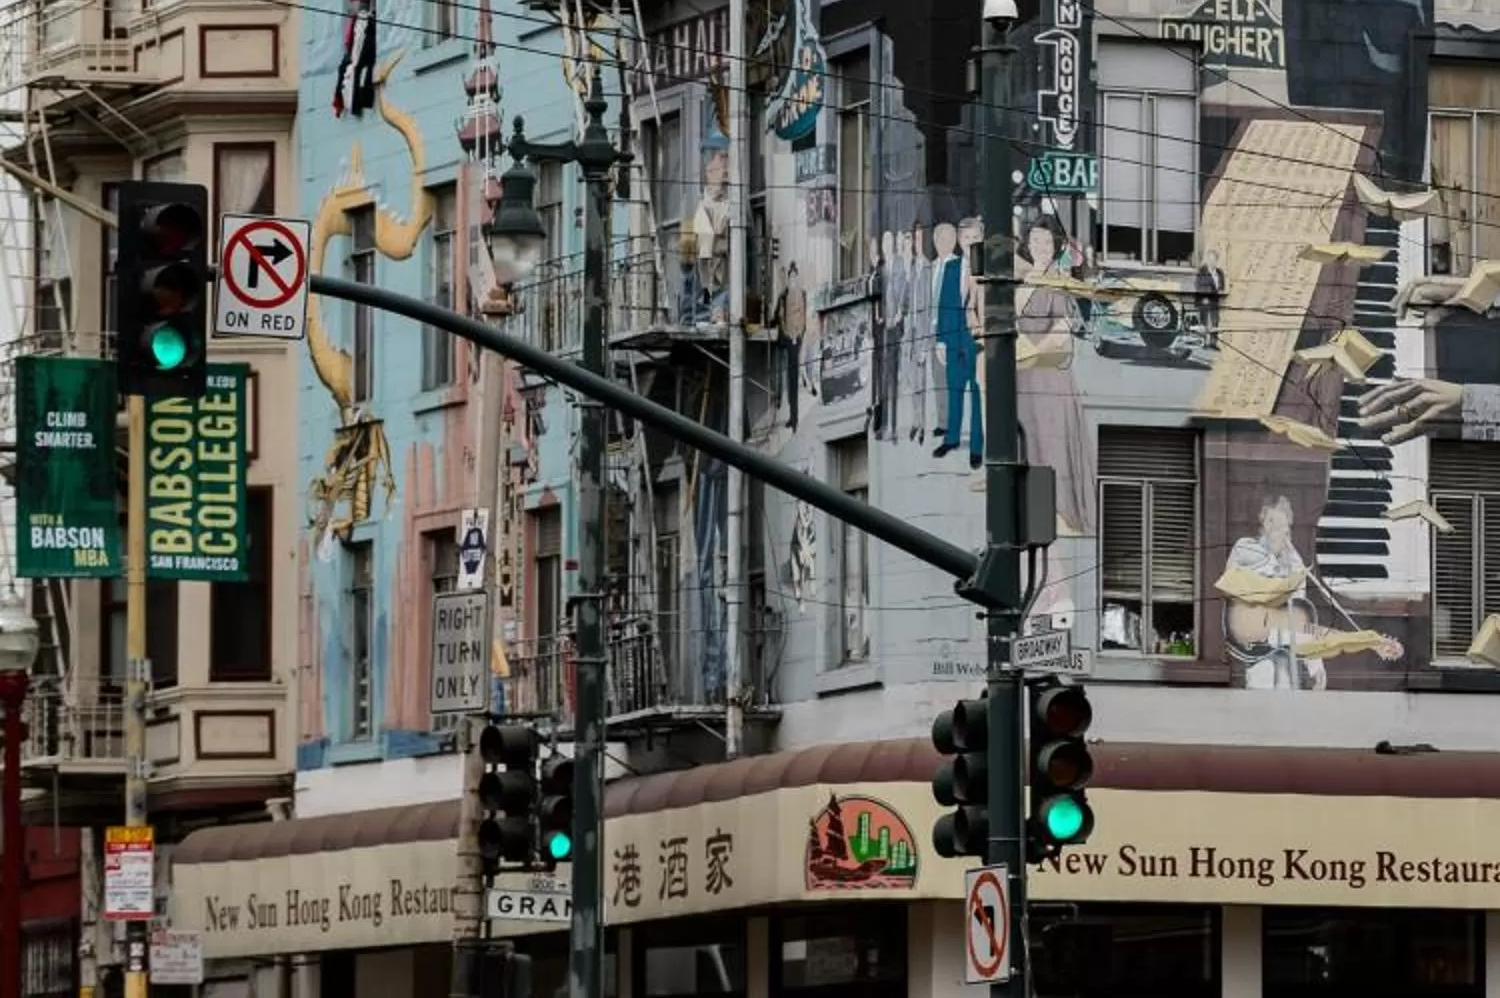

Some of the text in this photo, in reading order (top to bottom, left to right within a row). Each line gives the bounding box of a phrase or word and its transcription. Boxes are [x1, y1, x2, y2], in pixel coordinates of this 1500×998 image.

[1058, 38, 1074, 133] ROUGE
[225, 311, 295, 331] ON RED
[46, 411, 87, 428] CLIMB
[34, 432, 97, 449] SMARTER.
[151, 396, 193, 554] BABSON
[198, 391, 238, 555] COLLEGE
[31, 527, 105, 549] BABSON
[73, 550, 110, 568] MBA
[151, 555, 239, 572] SAN FRANCISCO
[437, 606, 482, 631] RIGHT
[437, 640, 481, 666] TURN
[1017, 634, 1064, 662] BROADWAY
[435, 674, 480, 699] ONLY
[1117, 844, 1178, 879] Sun
[1188, 846, 1275, 887] Hong
[1282, 848, 1367, 889] Kong
[205, 895, 241, 932] New
[247, 893, 278, 930] Sun
[285, 889, 331, 933] Hong
[338, 884, 383, 928] Kong
[497, 894, 574, 917] GRAN
